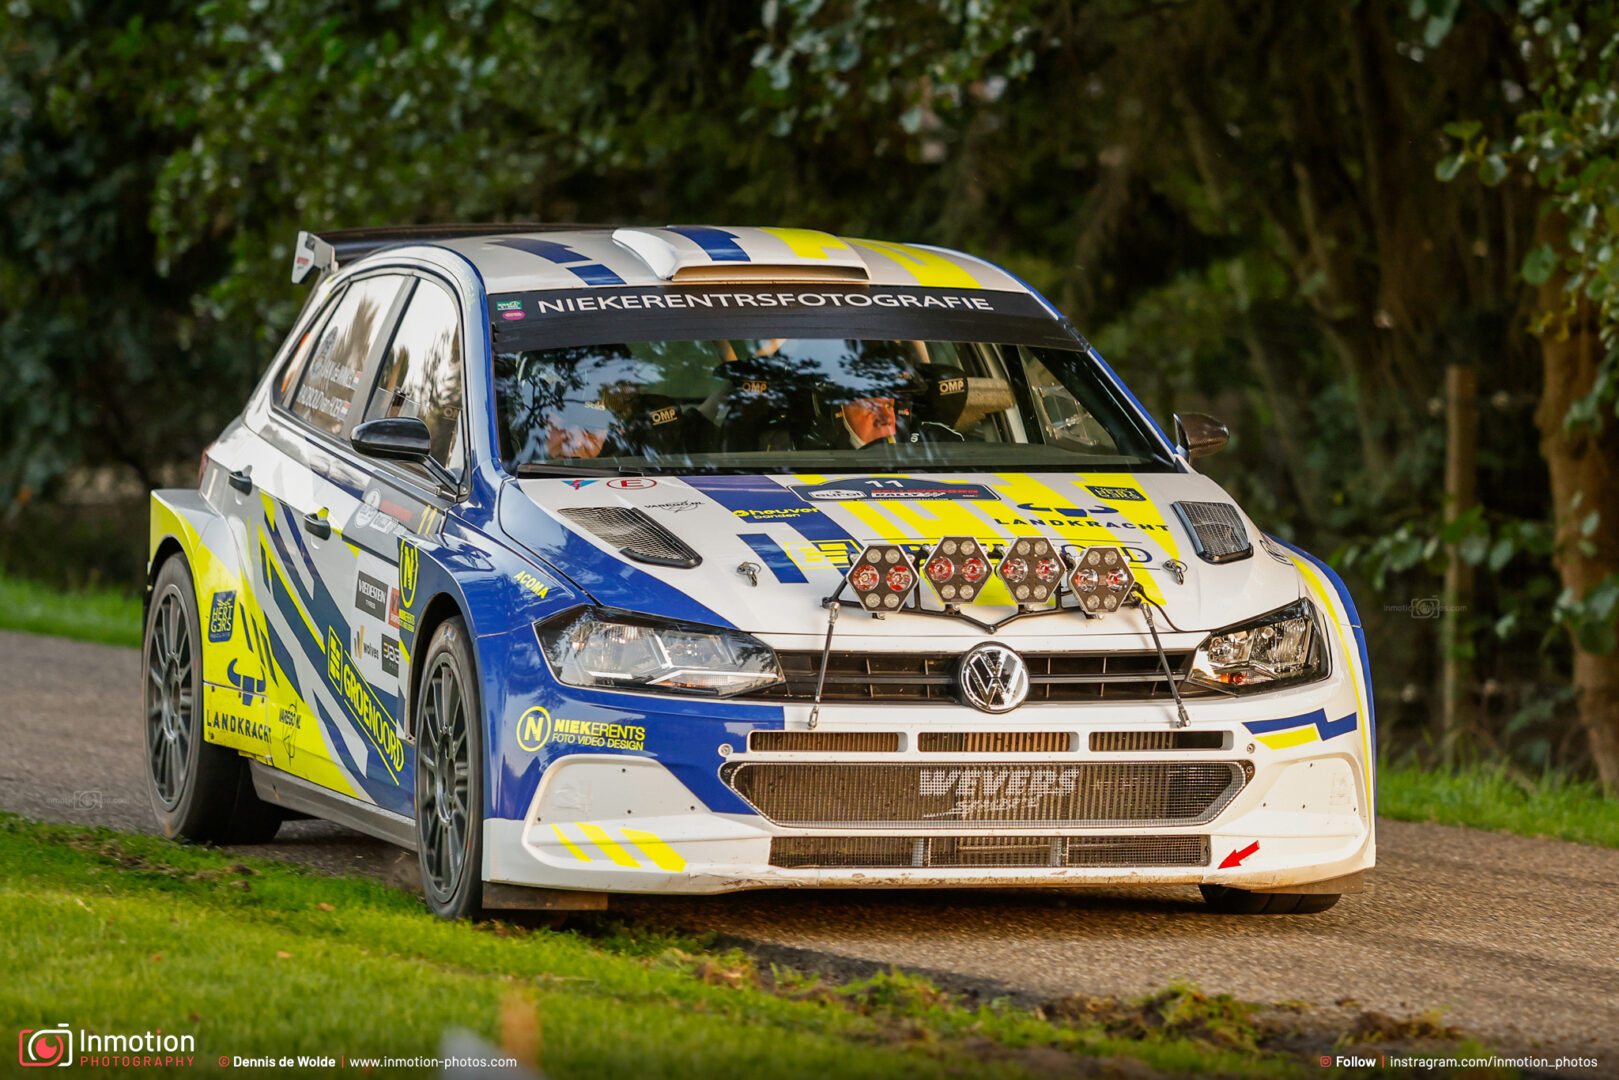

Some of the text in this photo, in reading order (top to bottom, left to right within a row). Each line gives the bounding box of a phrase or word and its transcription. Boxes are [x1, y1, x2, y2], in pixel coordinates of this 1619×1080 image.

[538, 293, 994, 314] NIEKERENTRSFOTOGRAFIE
[939, 381, 965, 393] OMP
[651, 408, 677, 424] OMP
[865, 479, 904, 488] 11
[994, 518, 1169, 532] LANDKRACHT
[513, 570, 550, 599] ACOMA
[206, 708, 273, 745] LANDKRACHT
[343, 662, 406, 773] GROENOORD
[553, 719, 646, 741] NIEKERENTS
[551, 733, 645, 751] FOTO VIDEO DESIGN
[920, 769, 1080, 797] WEVERS
